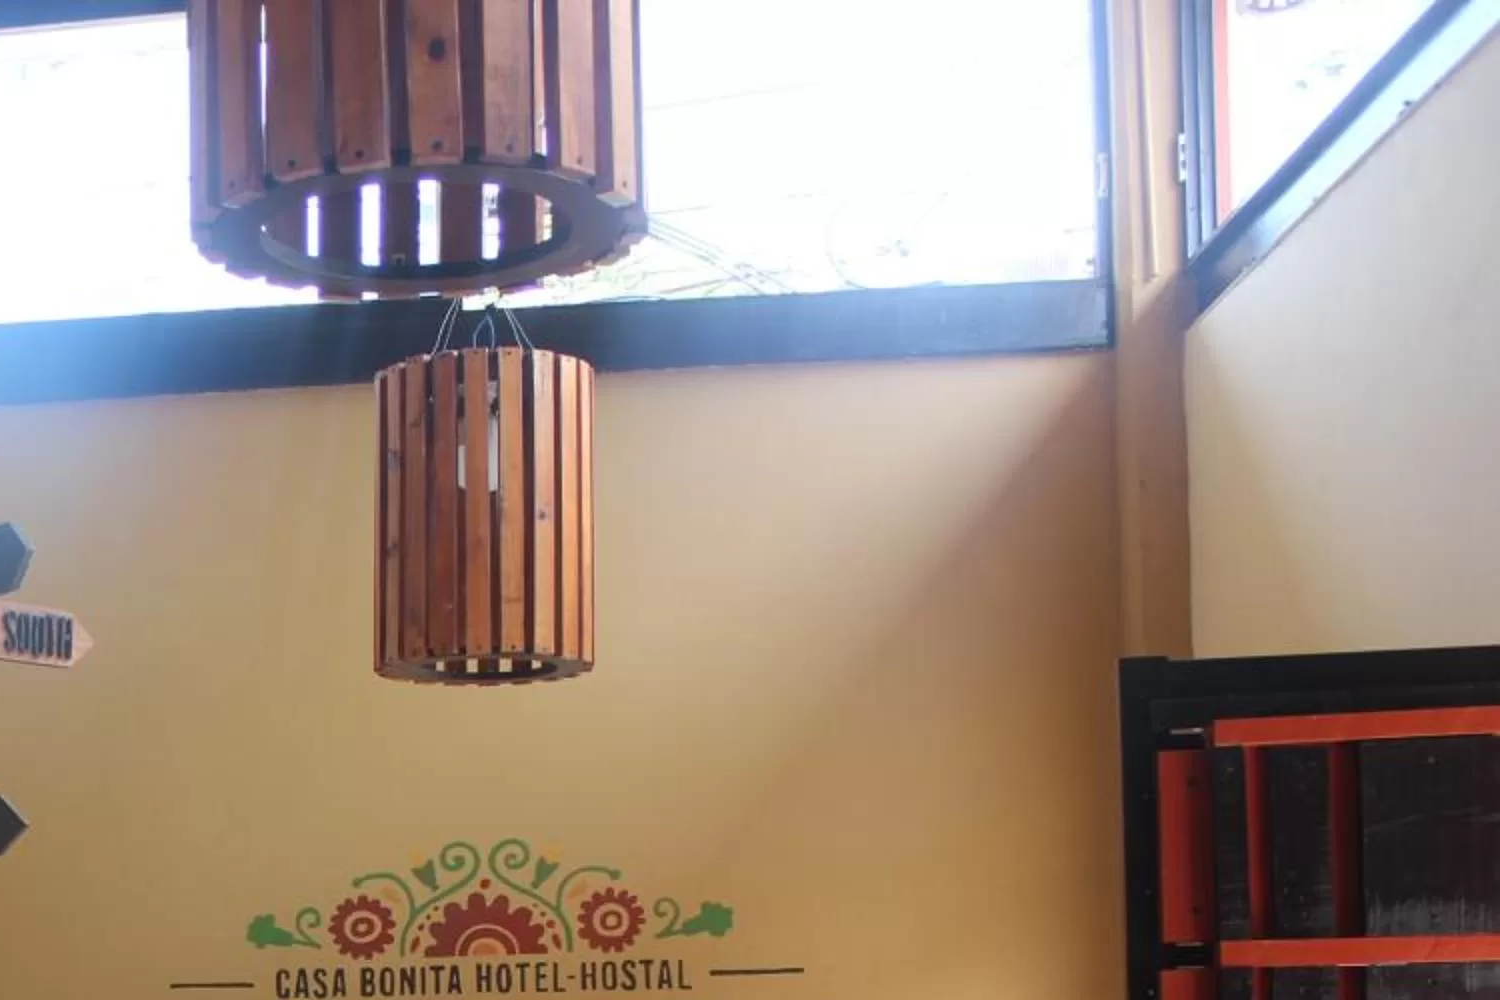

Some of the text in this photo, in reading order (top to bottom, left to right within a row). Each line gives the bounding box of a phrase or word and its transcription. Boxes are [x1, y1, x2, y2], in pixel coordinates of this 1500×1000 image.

[2, 609, 74, 661] SOUTH
[275, 967, 348, 999] CASA
[360, 964, 464, 998] BONITA
